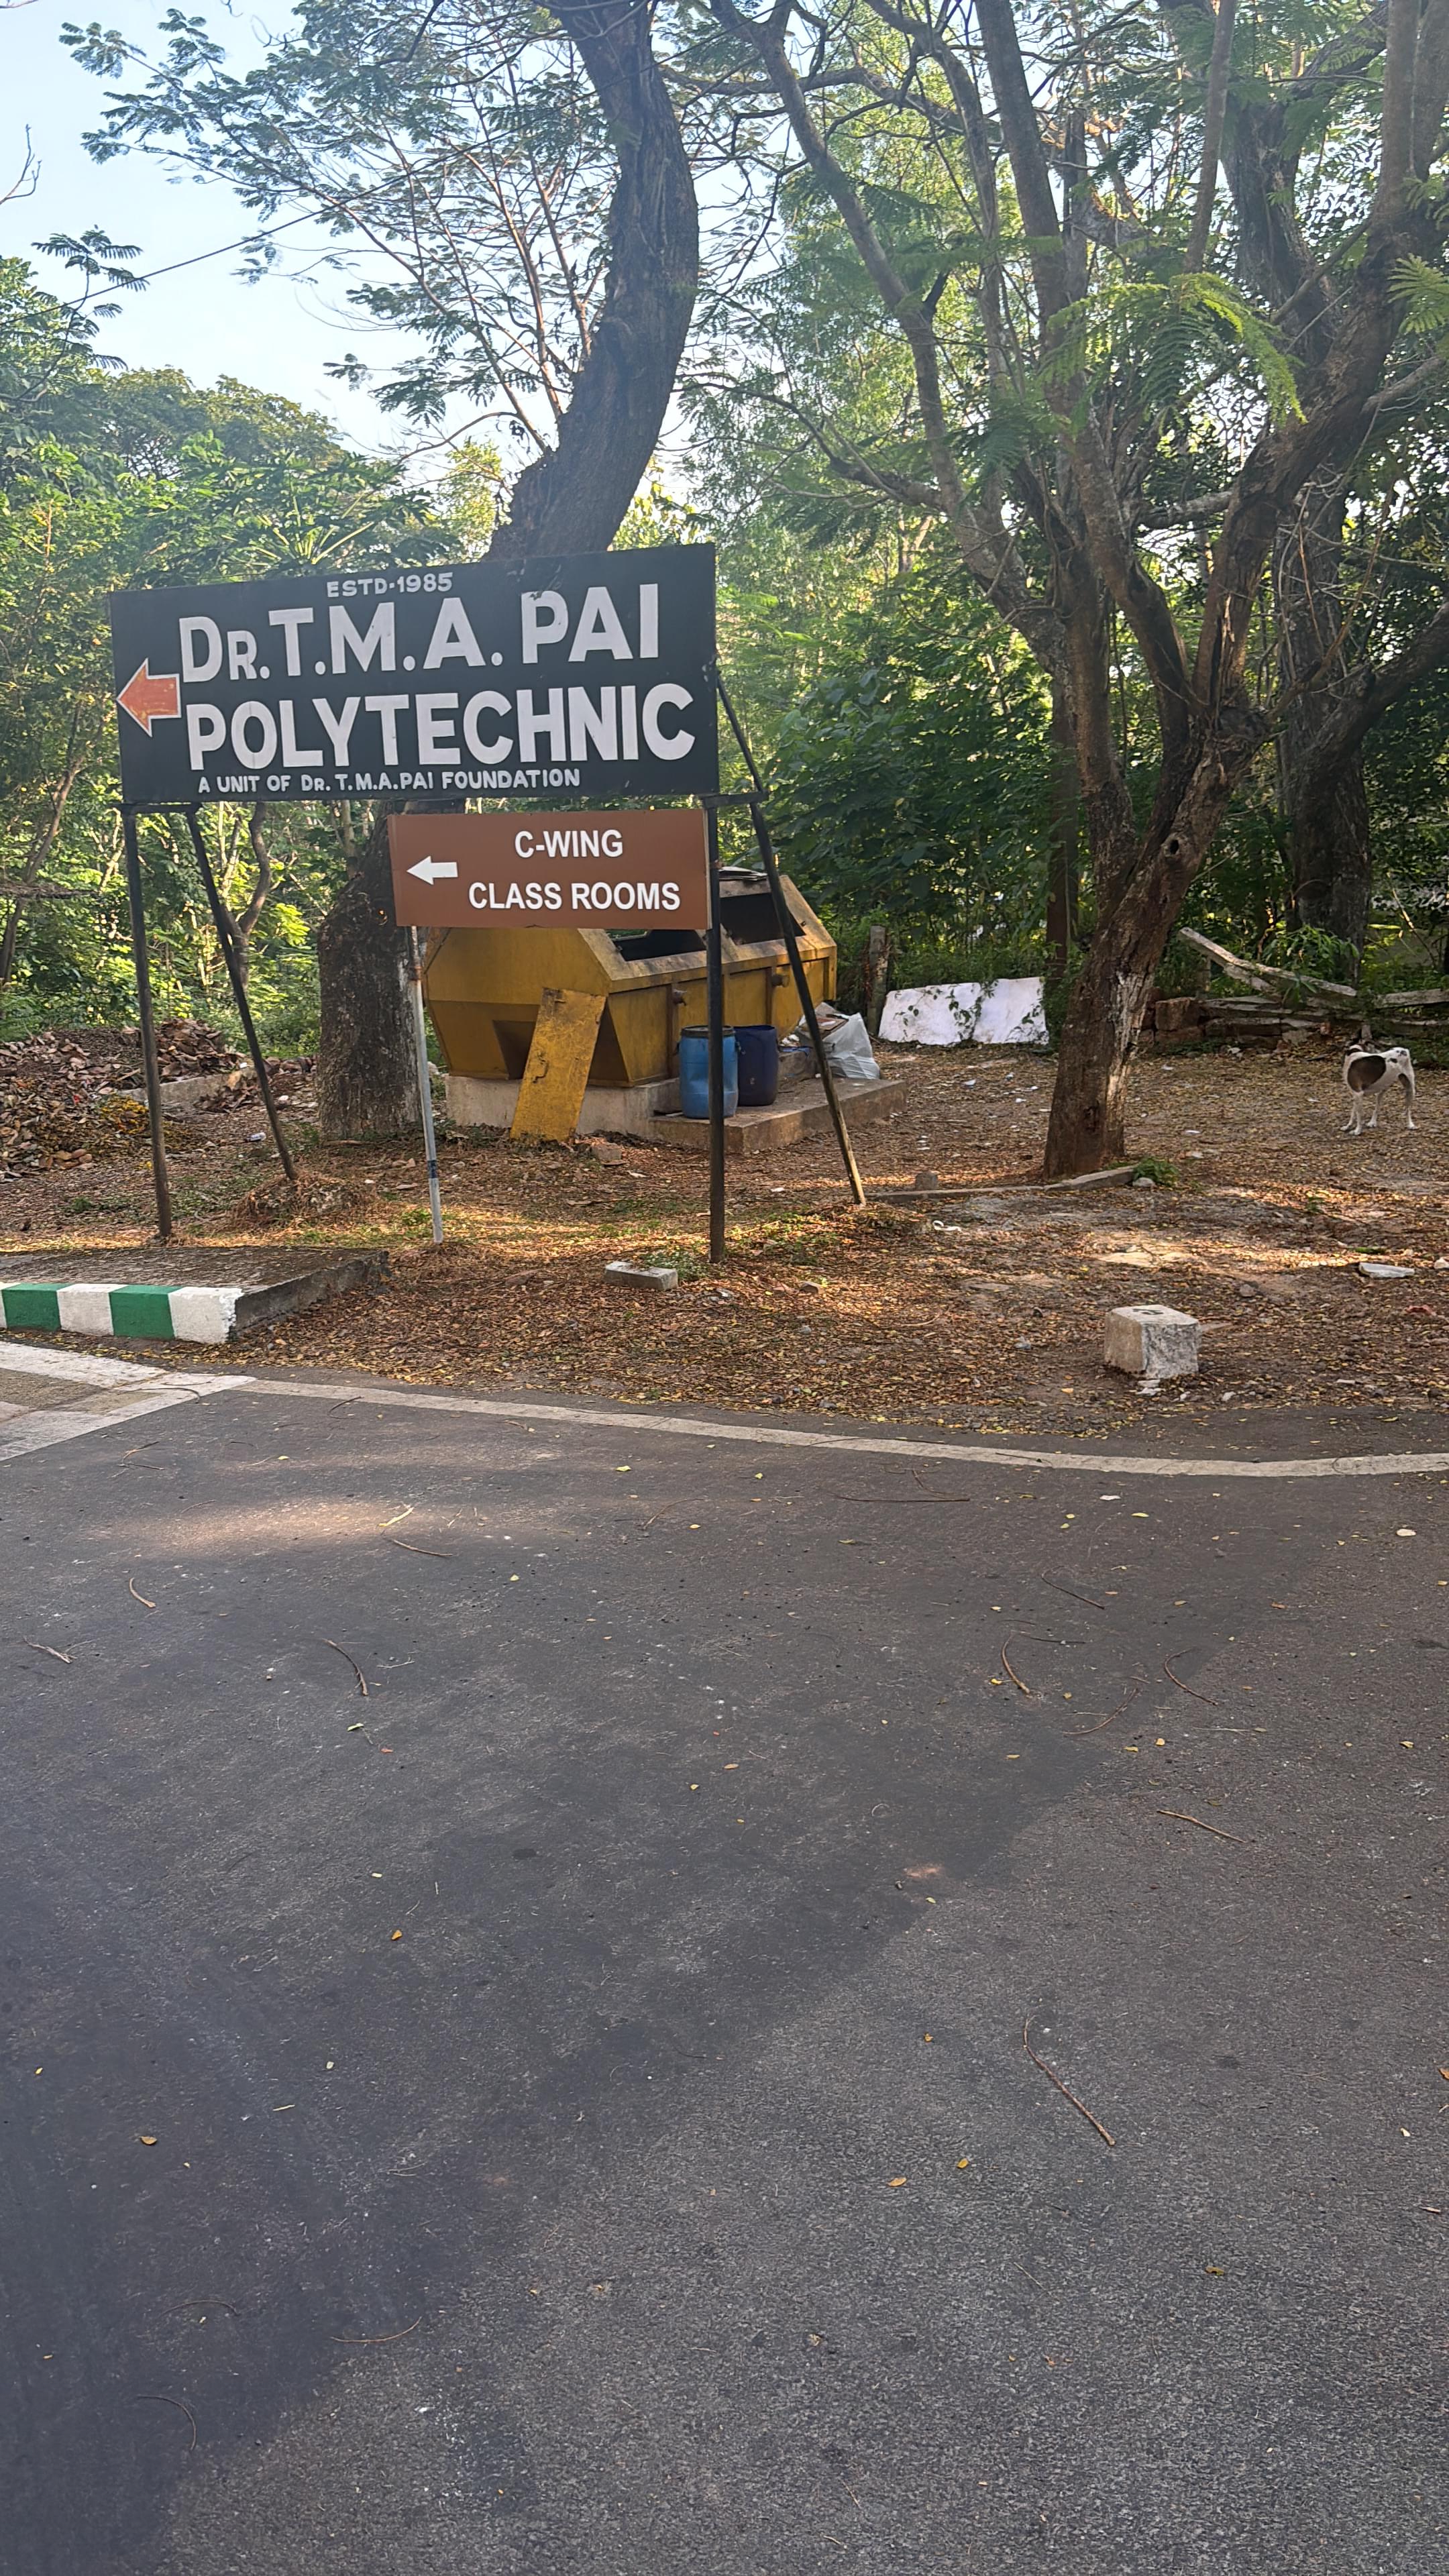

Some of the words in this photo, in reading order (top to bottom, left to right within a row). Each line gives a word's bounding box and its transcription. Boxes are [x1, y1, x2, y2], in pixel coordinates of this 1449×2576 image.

[521, 583, 659, 664] PAI
[186, 683, 696, 770] POLYTECHNIC
[198, 776, 211, 794] A
[217, 775, 260, 793] UNIT
[266, 775, 291, 792] OF
[441, 768, 580, 790] FOUNDATION
[515, 829, 623, 858] C-WING
[468, 881, 562, 910] CLASS
[571, 881, 680, 910] ROOMS
